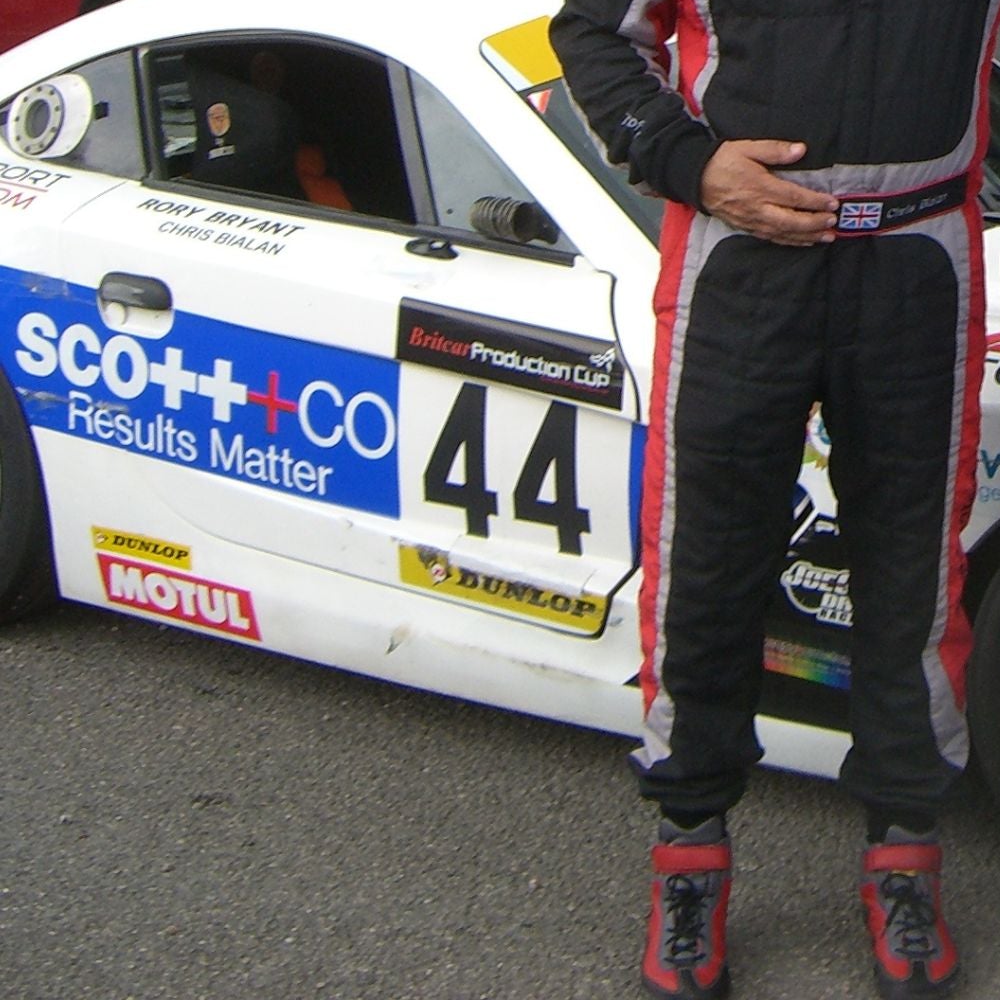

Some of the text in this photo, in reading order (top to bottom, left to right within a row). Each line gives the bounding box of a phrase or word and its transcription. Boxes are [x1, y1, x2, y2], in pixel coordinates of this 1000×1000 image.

[137, 198, 306, 238] RORY BRYANT
[157, 221, 286, 256] CHRIS BIALAN
[408, 326, 471, 356] Britcar
[469, 342, 572, 382] Production
[573, 365, 611, 388] Cup
[67, 391, 333, 496] Results Matter
[423, 382, 592, 557] 44
[112, 533, 190, 562] DUNLOP
[108, 562, 251, 631] MOTUL
[456, 568, 597, 618] DUNLOP
